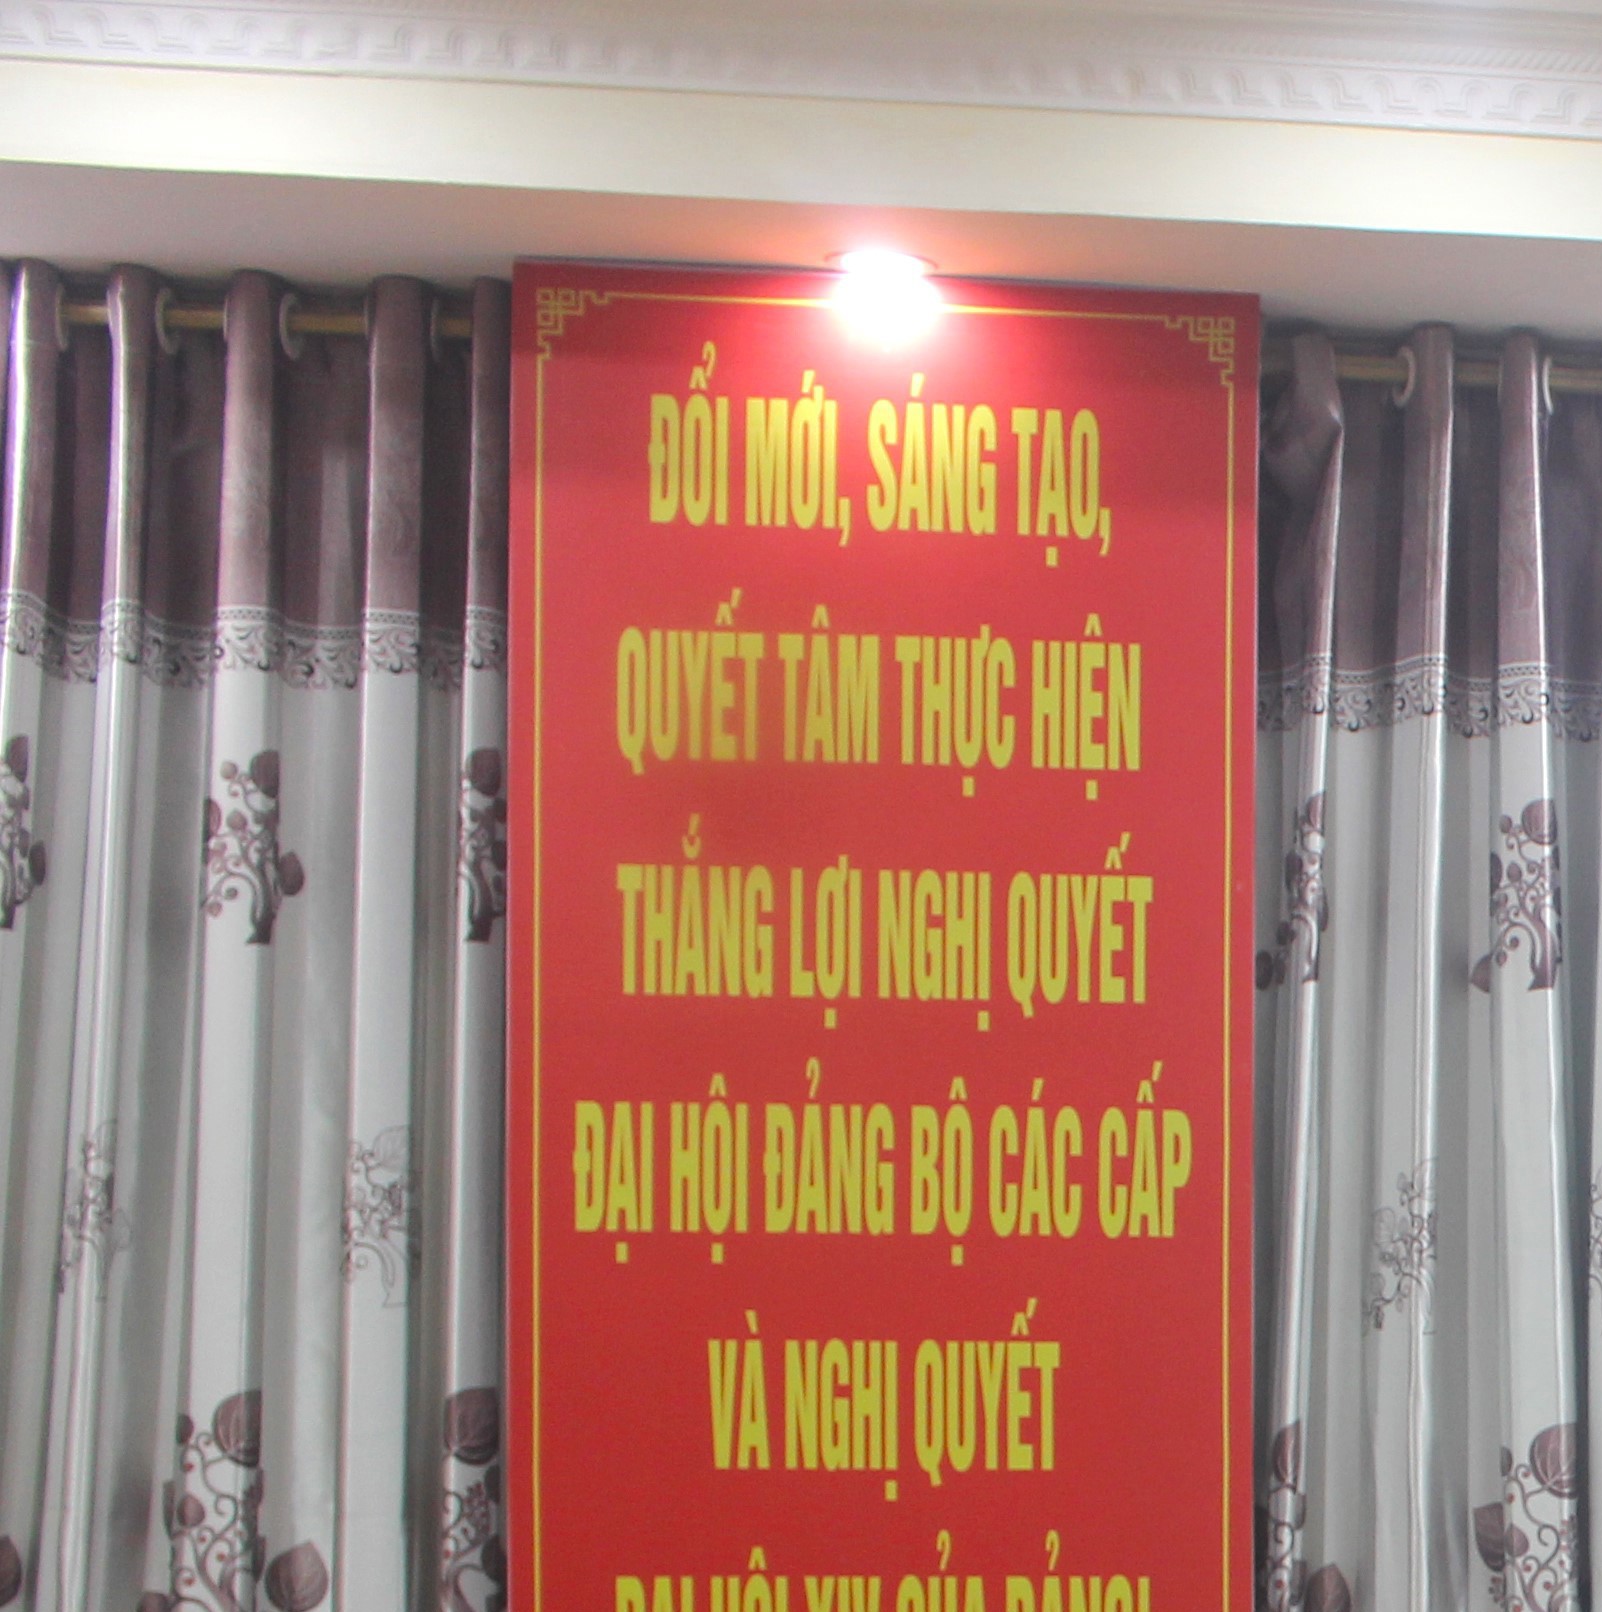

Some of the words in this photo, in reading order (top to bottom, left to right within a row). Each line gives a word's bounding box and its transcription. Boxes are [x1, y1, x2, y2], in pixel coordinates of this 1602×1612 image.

[649, 343, 729, 525] ĐỔI
[746, 370, 851, 544] MỚI,
[868, 379, 997, 534] SÁNG
[1012, 408, 1111, 566] TẠO,
[617, 589, 766, 774] QUYẾT
[778, 606, 880, 763] TÂM
[896, 626, 1016, 796] THỰC
[1032, 614, 1141, 800] HIỆN
[618, 816, 774, 997] THẮNG
[791, 856, 862, 1028] LỢI
[879, 870, 991, 1031] NGHỊ
[1008, 833, 1153, 1017] QUYẾT
[574, 1101, 654, 1262] ĐẠI
[671, 1075, 749, 1263] HỘI
[763, 1059, 895, 1235] ĐẢNG
[911, 1077, 973, 1264] BỘ
[989, 1079, 1083, 1237] CÁC
[1099, 1062, 1192, 1238] CẤP
[709, 1311, 771, 1469] VÀ
[785, 1339, 899, 1500] NGHỊ
[915, 1299, 1060, 1485] QUYẾT
